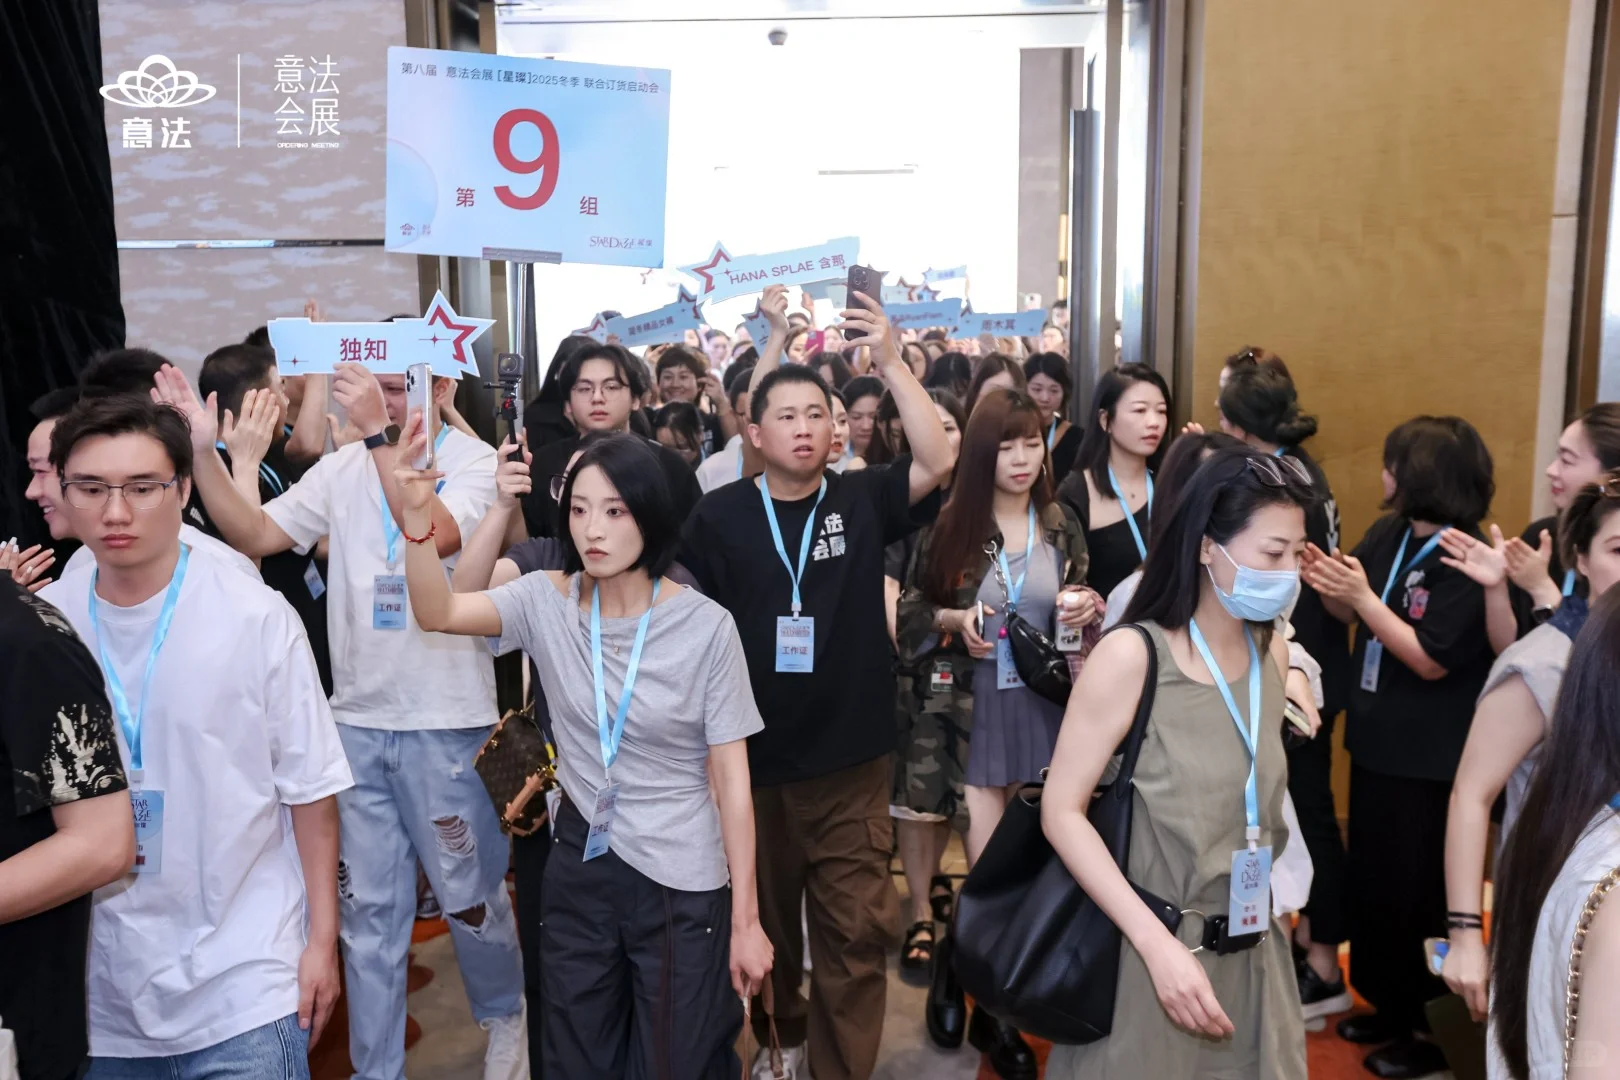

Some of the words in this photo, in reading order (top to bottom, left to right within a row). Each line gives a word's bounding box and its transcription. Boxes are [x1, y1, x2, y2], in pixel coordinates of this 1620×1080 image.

[401, 62, 437, 77] 第八届
[446, 66, 493, 81] 意法会展
[583, 77, 659, 94] 联合订货启动会
[493, 108, 560, 210] 9
[456, 187, 475, 207] 第
[579, 196, 599, 215] 组
[729, 269, 768, 285] HANA
[771, 260, 815, 277] SPLAE
[340, 337, 387, 361] 独知
[819, 512, 844, 537] 法
[812, 534, 846, 561] 会展
[782, 646, 808, 655] 工作证
